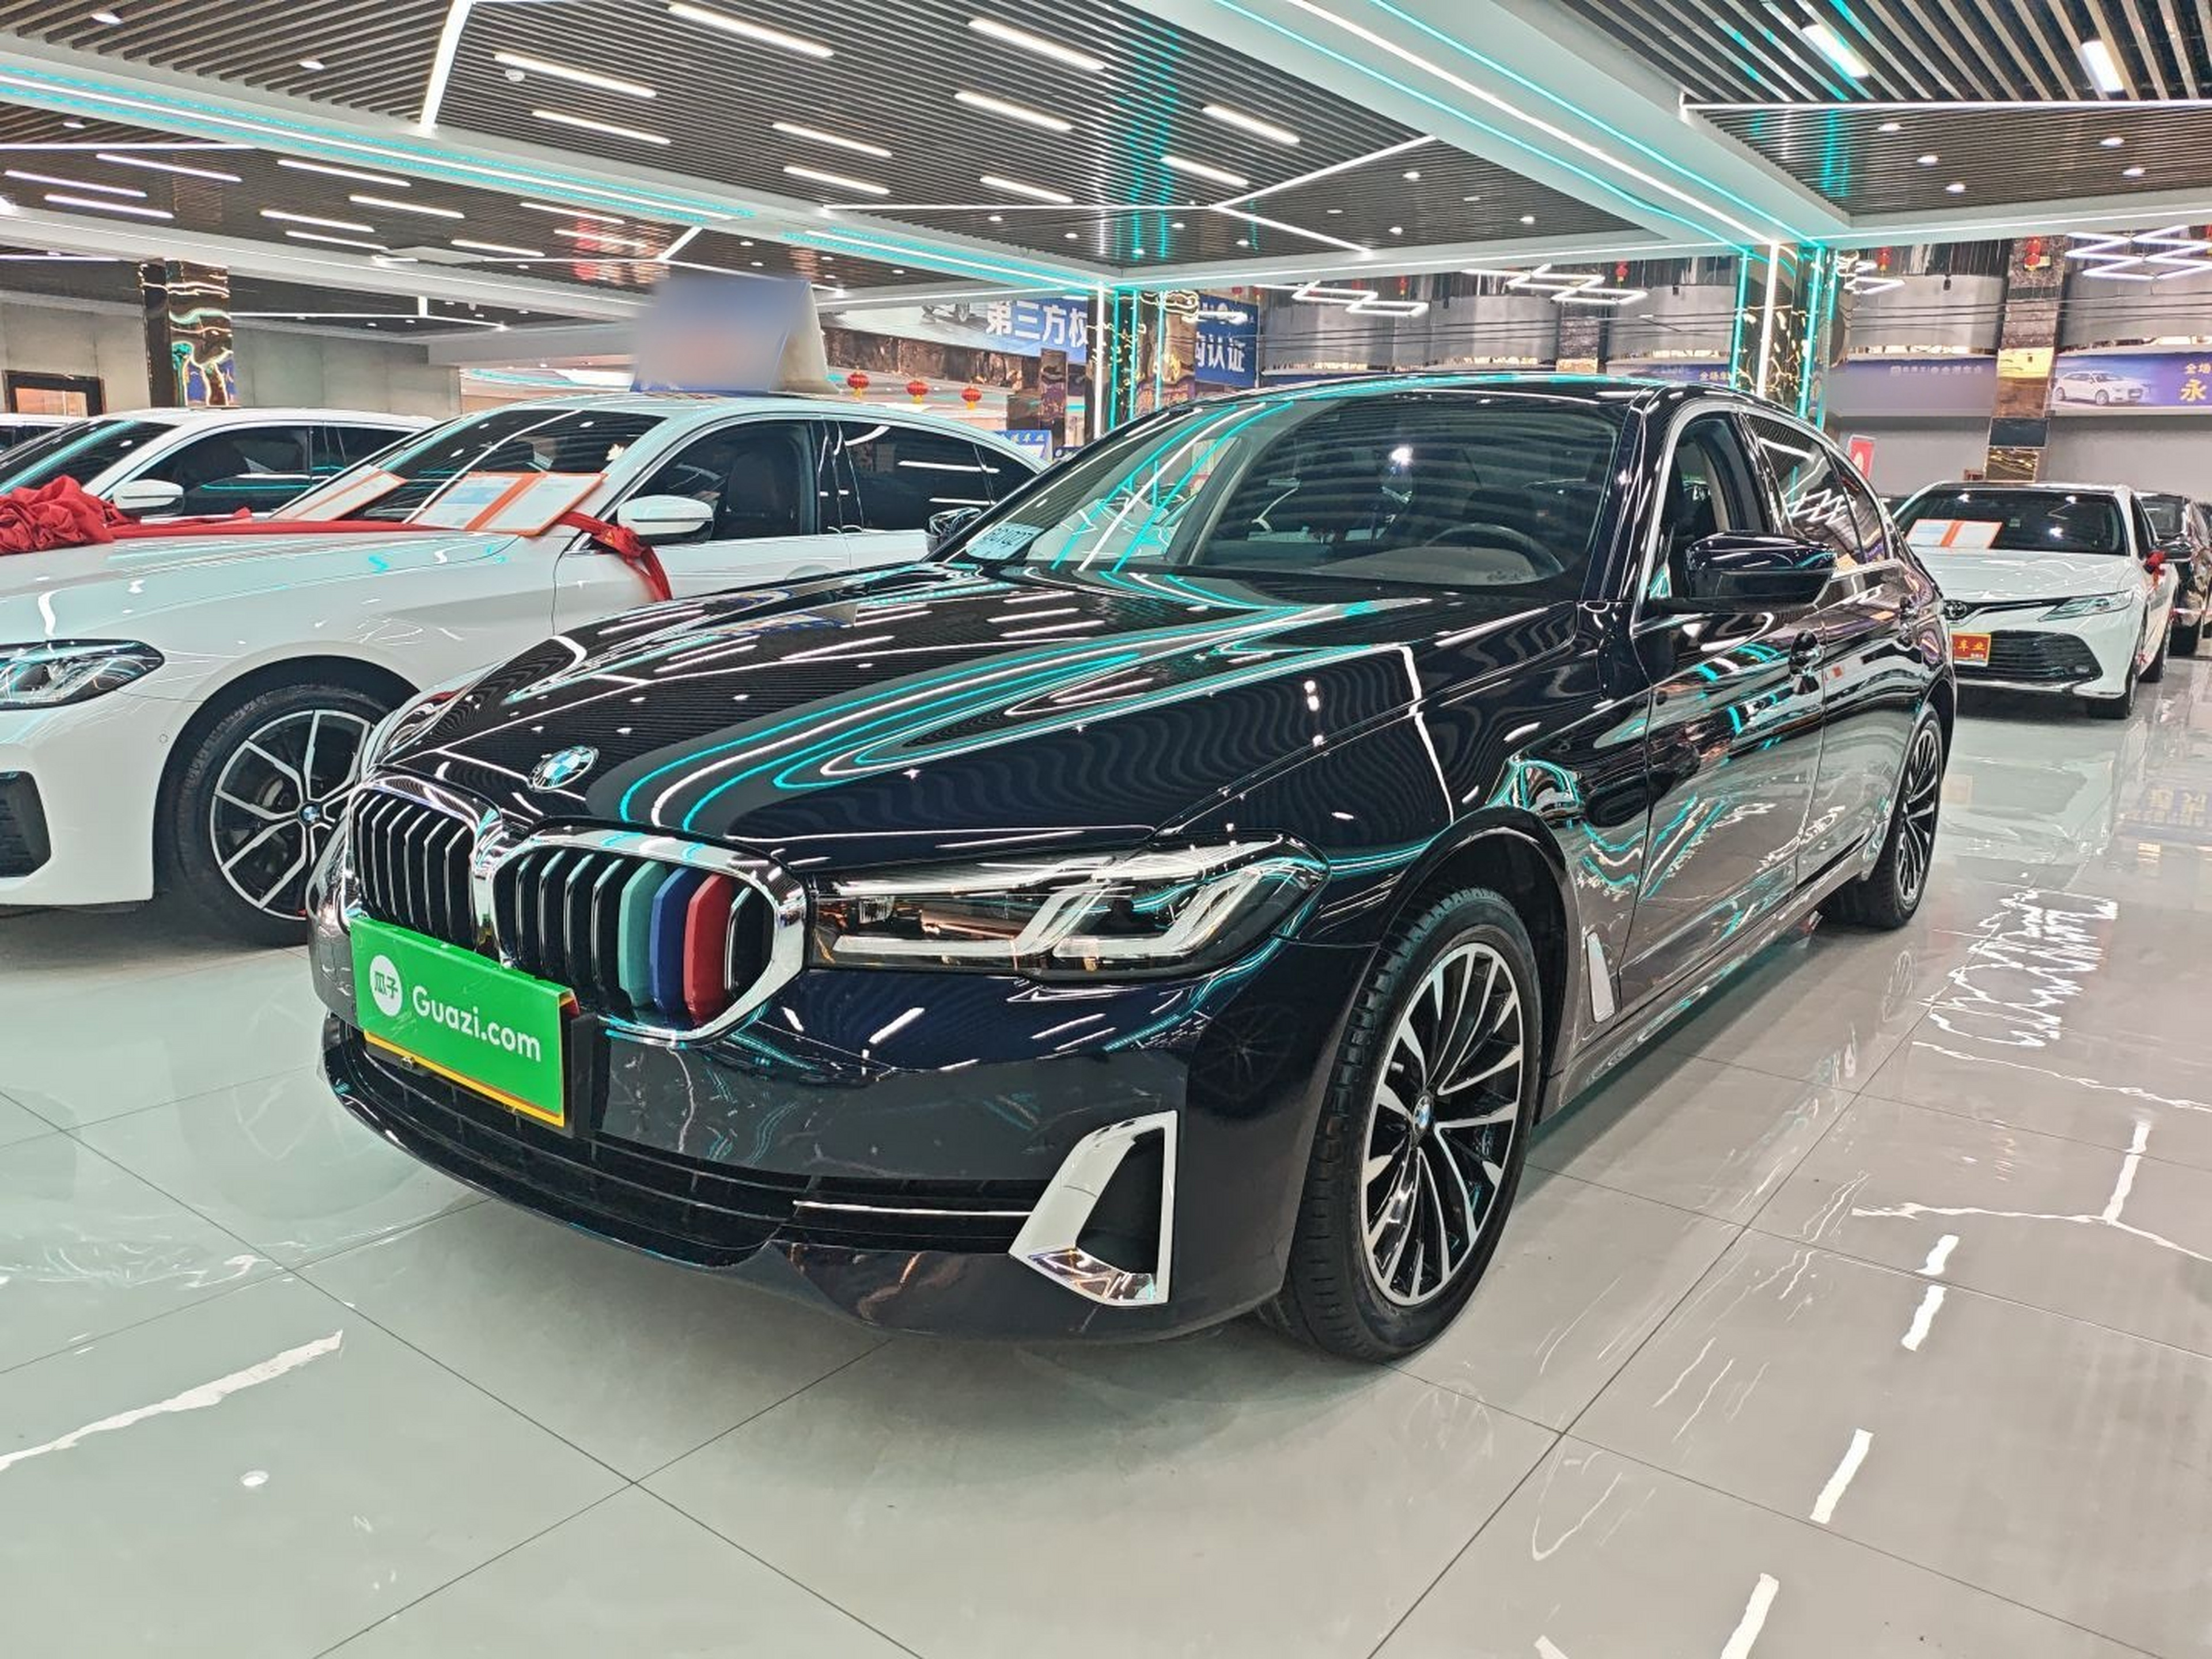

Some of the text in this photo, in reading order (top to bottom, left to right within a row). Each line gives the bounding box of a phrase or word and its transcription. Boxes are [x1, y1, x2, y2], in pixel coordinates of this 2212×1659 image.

[2180, 379, 2207, 402] 永
[374, 971, 399, 999] 瓜子
[412, 986, 541, 1062] Guazi.com
